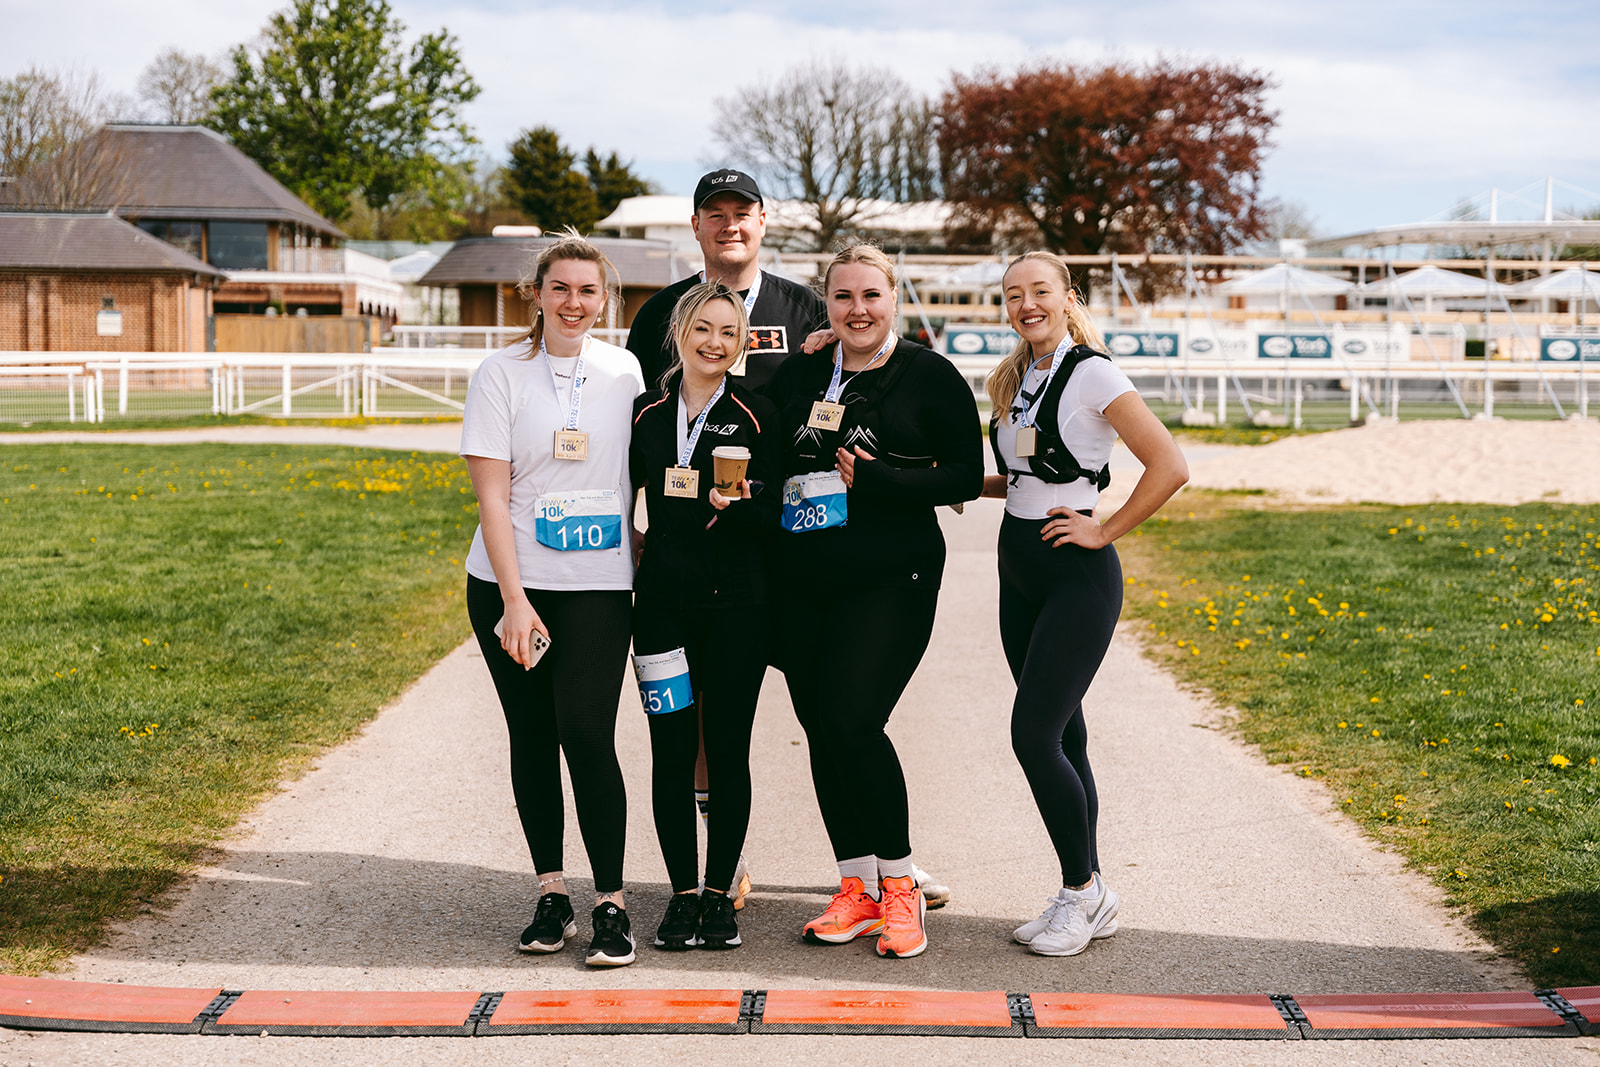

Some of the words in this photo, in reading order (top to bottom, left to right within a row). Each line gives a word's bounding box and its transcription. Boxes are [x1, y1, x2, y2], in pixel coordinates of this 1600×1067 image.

[816, 412, 831, 422] 10k
[560, 443, 577, 452] 10k
[671, 480, 687, 490] 10k
[786, 490, 802, 503] 10k
[541, 505, 565, 519] 10k
[791, 504, 828, 531] 288
[557, 524, 603, 549] 110
